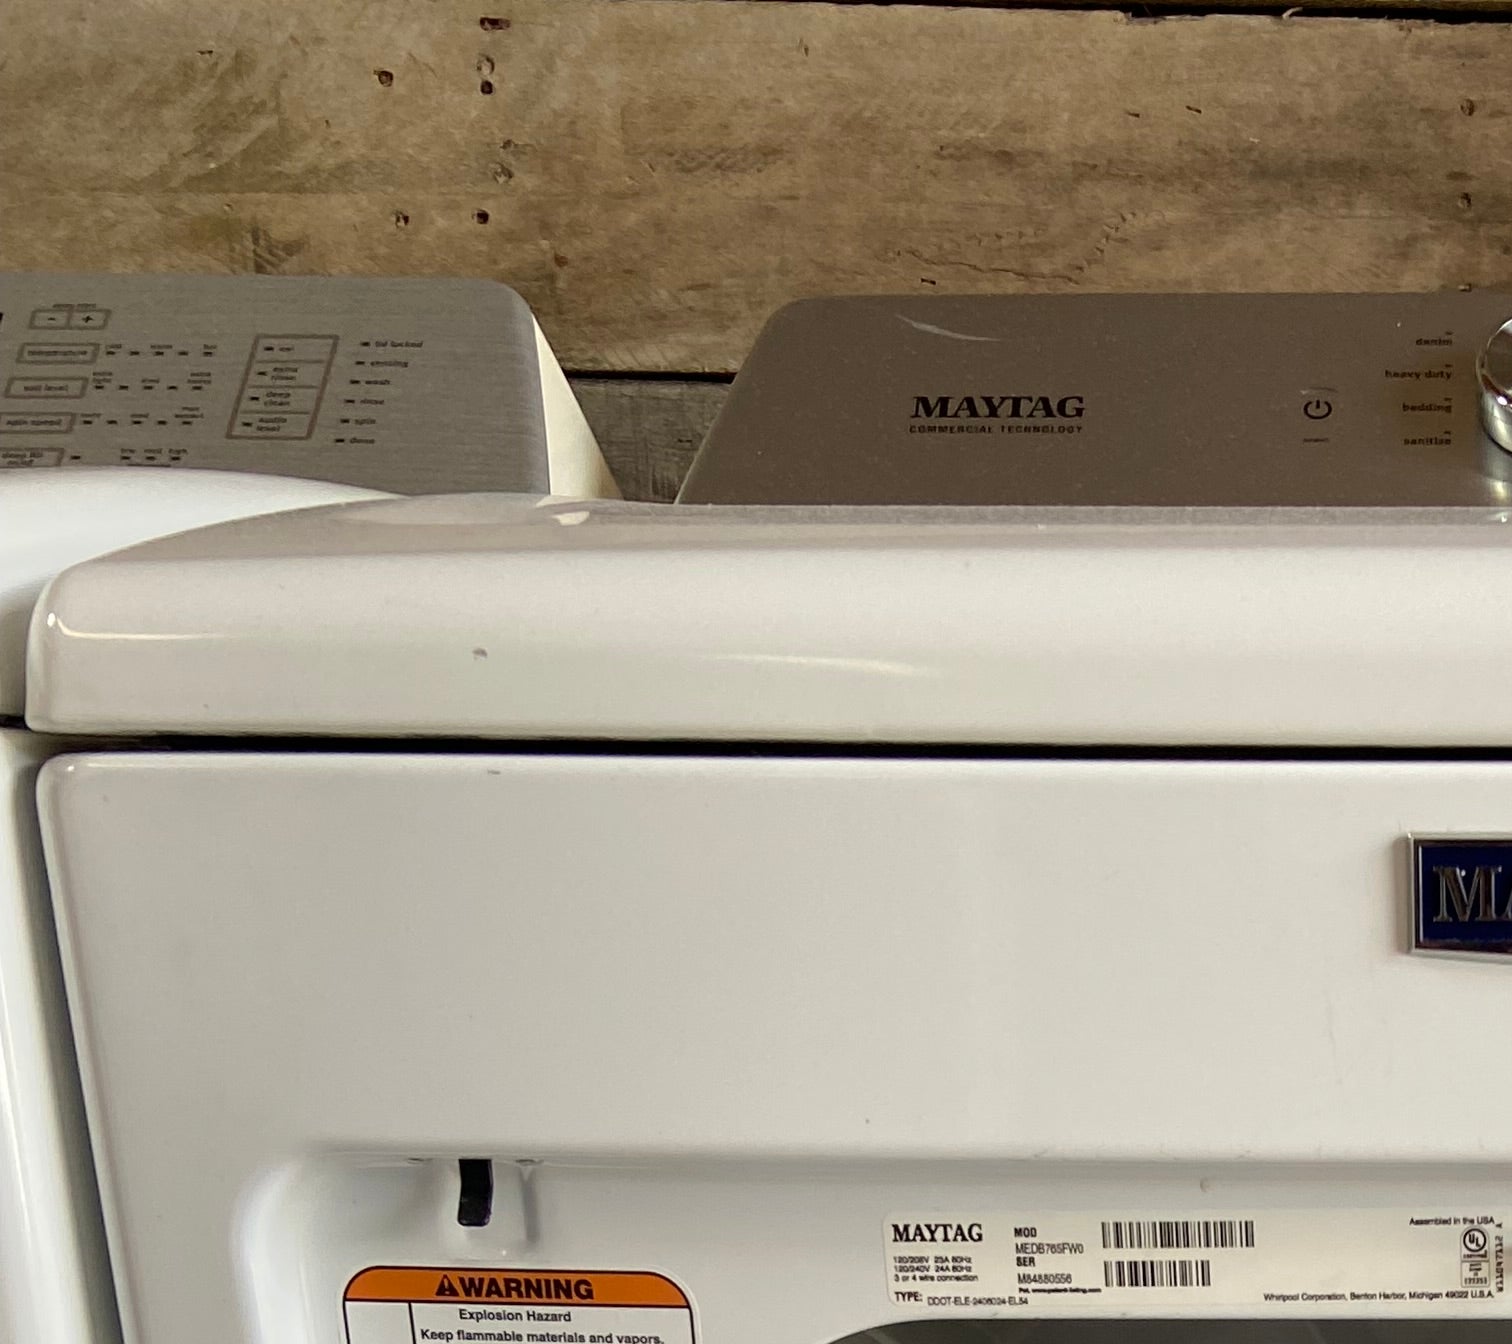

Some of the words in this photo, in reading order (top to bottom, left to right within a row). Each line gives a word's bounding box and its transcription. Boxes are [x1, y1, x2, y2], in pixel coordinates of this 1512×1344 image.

[1385, 369, 1423, 381] heavy
[1424, 369, 1452, 381] duty
[910, 396, 1085, 418] MAYTAG
[1402, 402, 1453, 414] bedding
[909, 424, 993, 434] COMMERCIAL
[1001, 424, 1083, 434] TECHNOLOGY
[1409, 1217, 1452, 1226] Assembled
[1453, 1217, 1461, 1225] in
[1462, 1217, 1475, 1225] the
[1476, 1216, 1495, 1225] USA
[892, 1223, 983, 1243] MAYTAG
[1014, 1227, 1037, 1238] MOD
[1016, 1256, 1036, 1267] SER
[460, 1277, 595, 1300] WARNING
[894, 1291, 923, 1302] TYPE:
[1263, 1293, 1300, 1302] Whirlpool
[1300, 1293, 1348, 1302] Corporation,
[1350, 1292, 1377, 1301] Benton
[1378, 1292, 1407, 1300] Harbor,
[1408, 1291, 1443, 1301] Michigan
[1445, 1290, 1469, 1299] 49022
[1470, 1290, 1495, 1299] U.S.A.
[458, 1308, 523, 1322] Explosion
[526, 1310, 572, 1322] Hazard
[420, 1328, 454, 1342] Keep
[456, 1329, 523, 1342] flammable
[526, 1332, 586, 1343] materials
[589, 1333, 614, 1344] and
